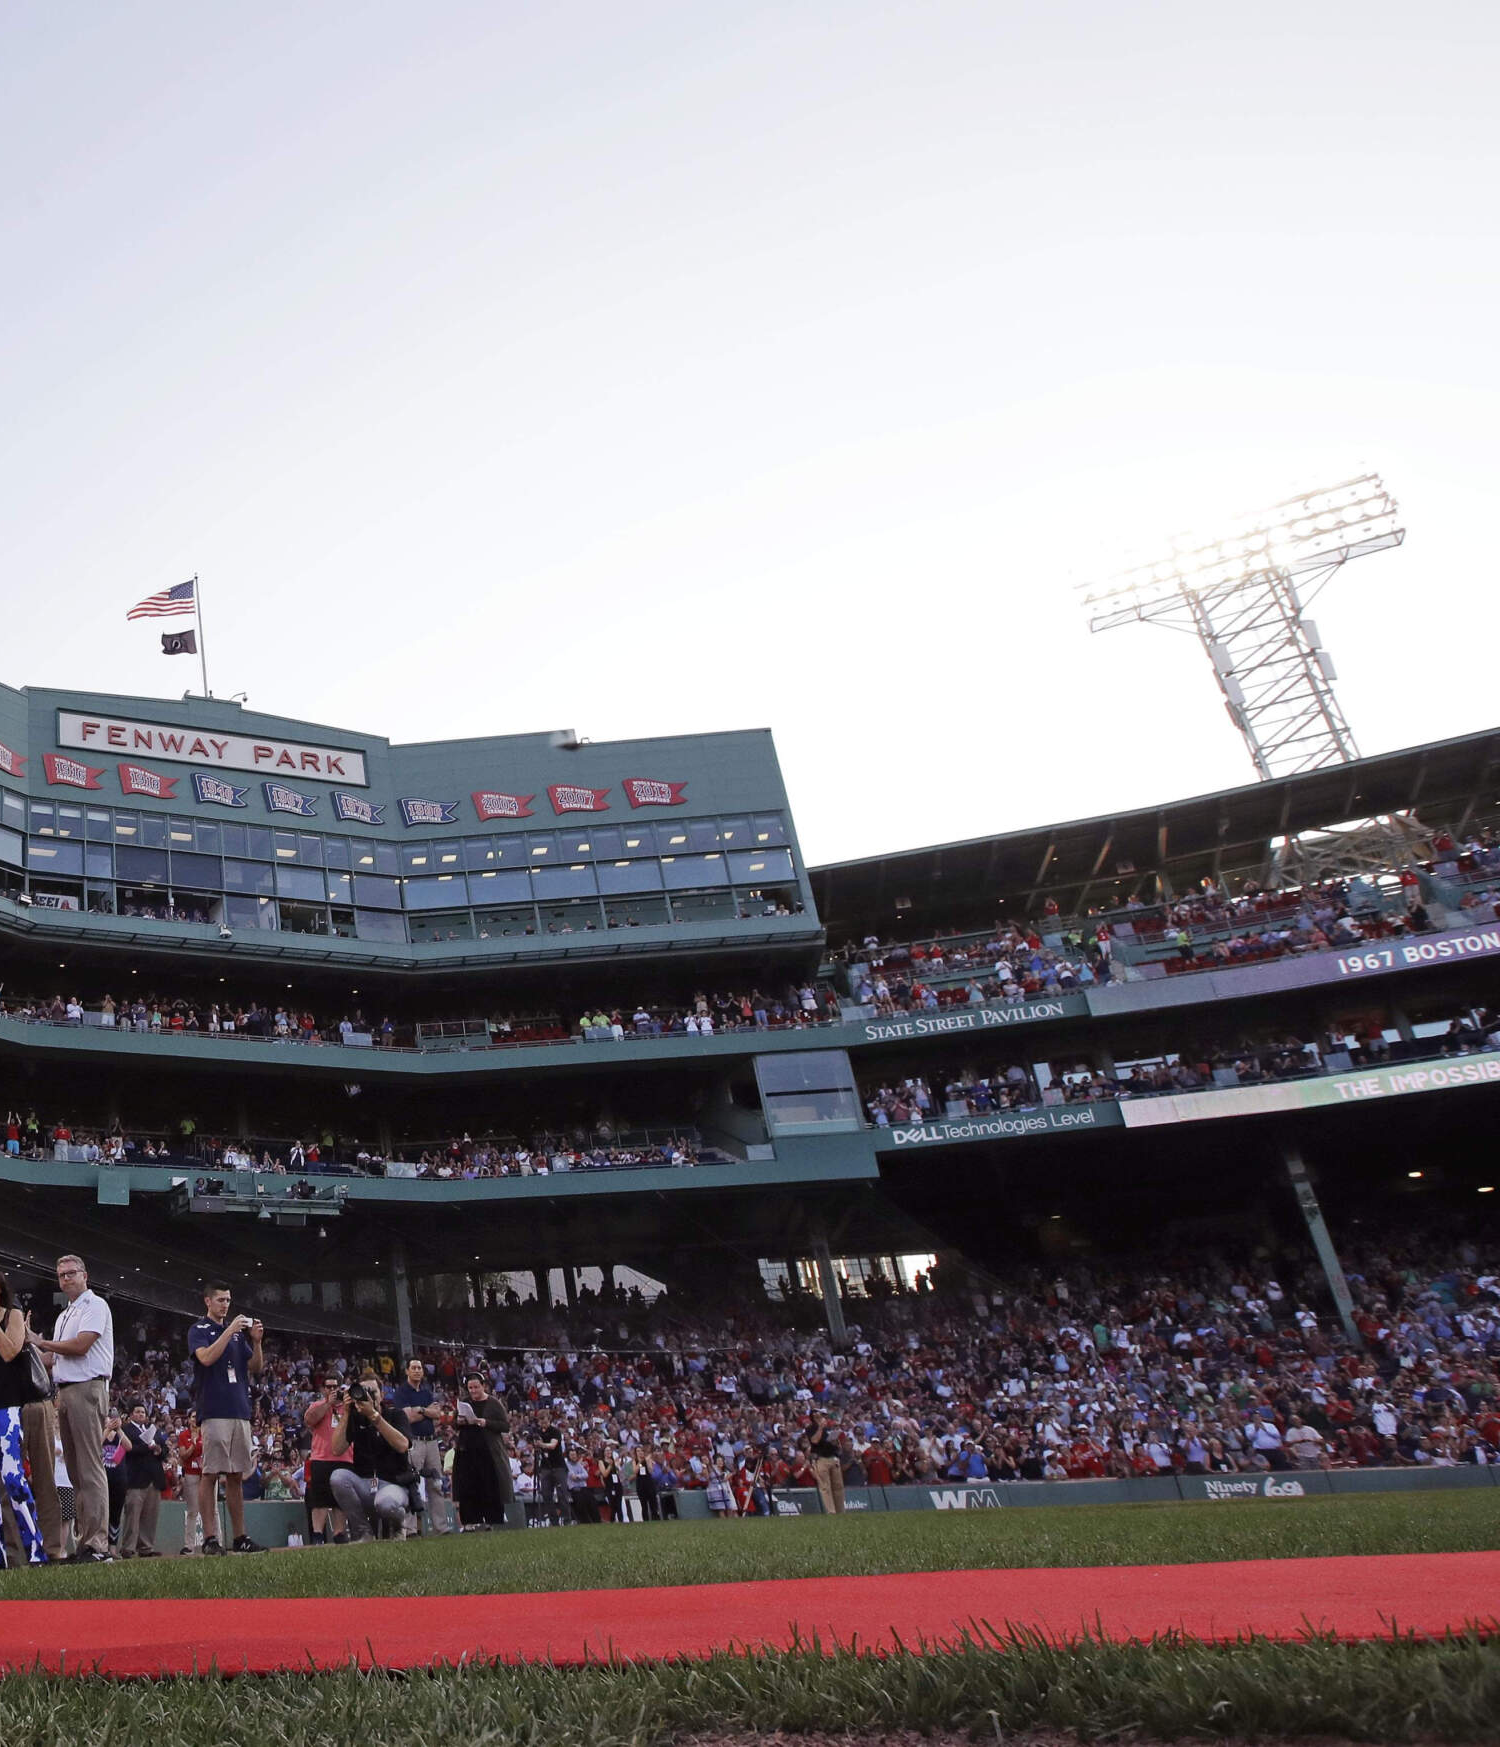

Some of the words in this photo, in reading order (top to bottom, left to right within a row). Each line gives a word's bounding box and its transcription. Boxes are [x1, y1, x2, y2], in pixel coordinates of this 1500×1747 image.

[81, 721, 229, 759] FENWAY
[253, 745, 345, 776] PARK
[556, 791, 595, 806] 2007
[633, 783, 671, 800] 2013
[481, 798, 519, 812] 2004
[36, 896, 60, 907] EEI
[1338, 951, 1394, 974] 1967
[1402, 931, 1500, 963] BOSTON
[865, 1024, 915, 1041] STATE
[915, 1014, 975, 1034] STREET
[979, 1002, 1065, 1026] PAVILION
[1333, 1077, 1386, 1099] THE
[1050, 1108, 1095, 1127] Level
[1204, 1481, 1258, 1494] Ninety
